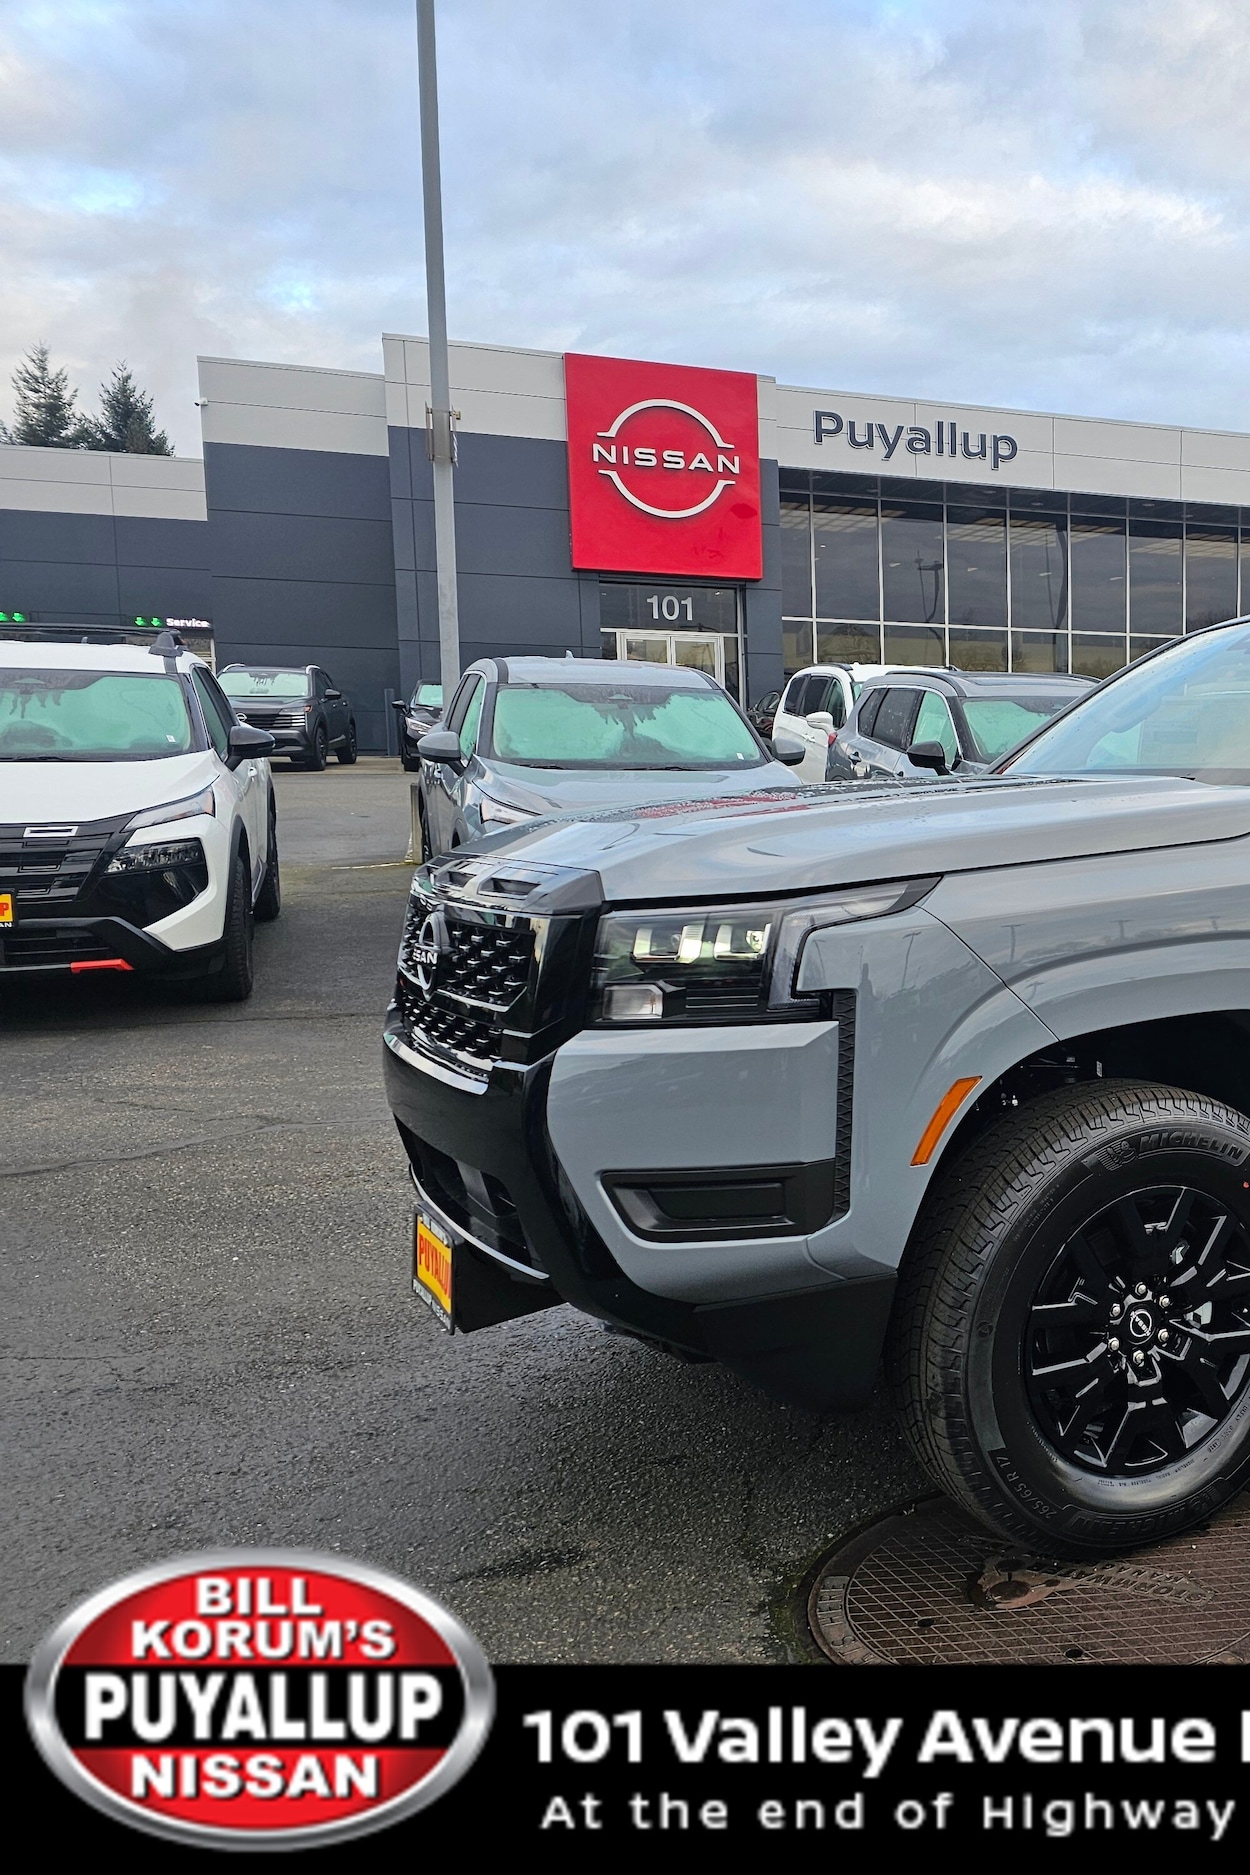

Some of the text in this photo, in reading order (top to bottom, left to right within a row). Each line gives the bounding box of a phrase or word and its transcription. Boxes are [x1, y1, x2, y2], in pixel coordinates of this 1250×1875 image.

[813, 410, 1018, 470] Puyallup
[592, 443, 740, 474] NISSAN
[166, 618, 211, 628] Service
[646, 595, 693, 621] 101
[1139, 1130, 1243, 1161] MICHELIN
[1130, 1310, 1151, 1337] NISSAN
[996, 1455, 1057, 1519] 265/65 R 17
